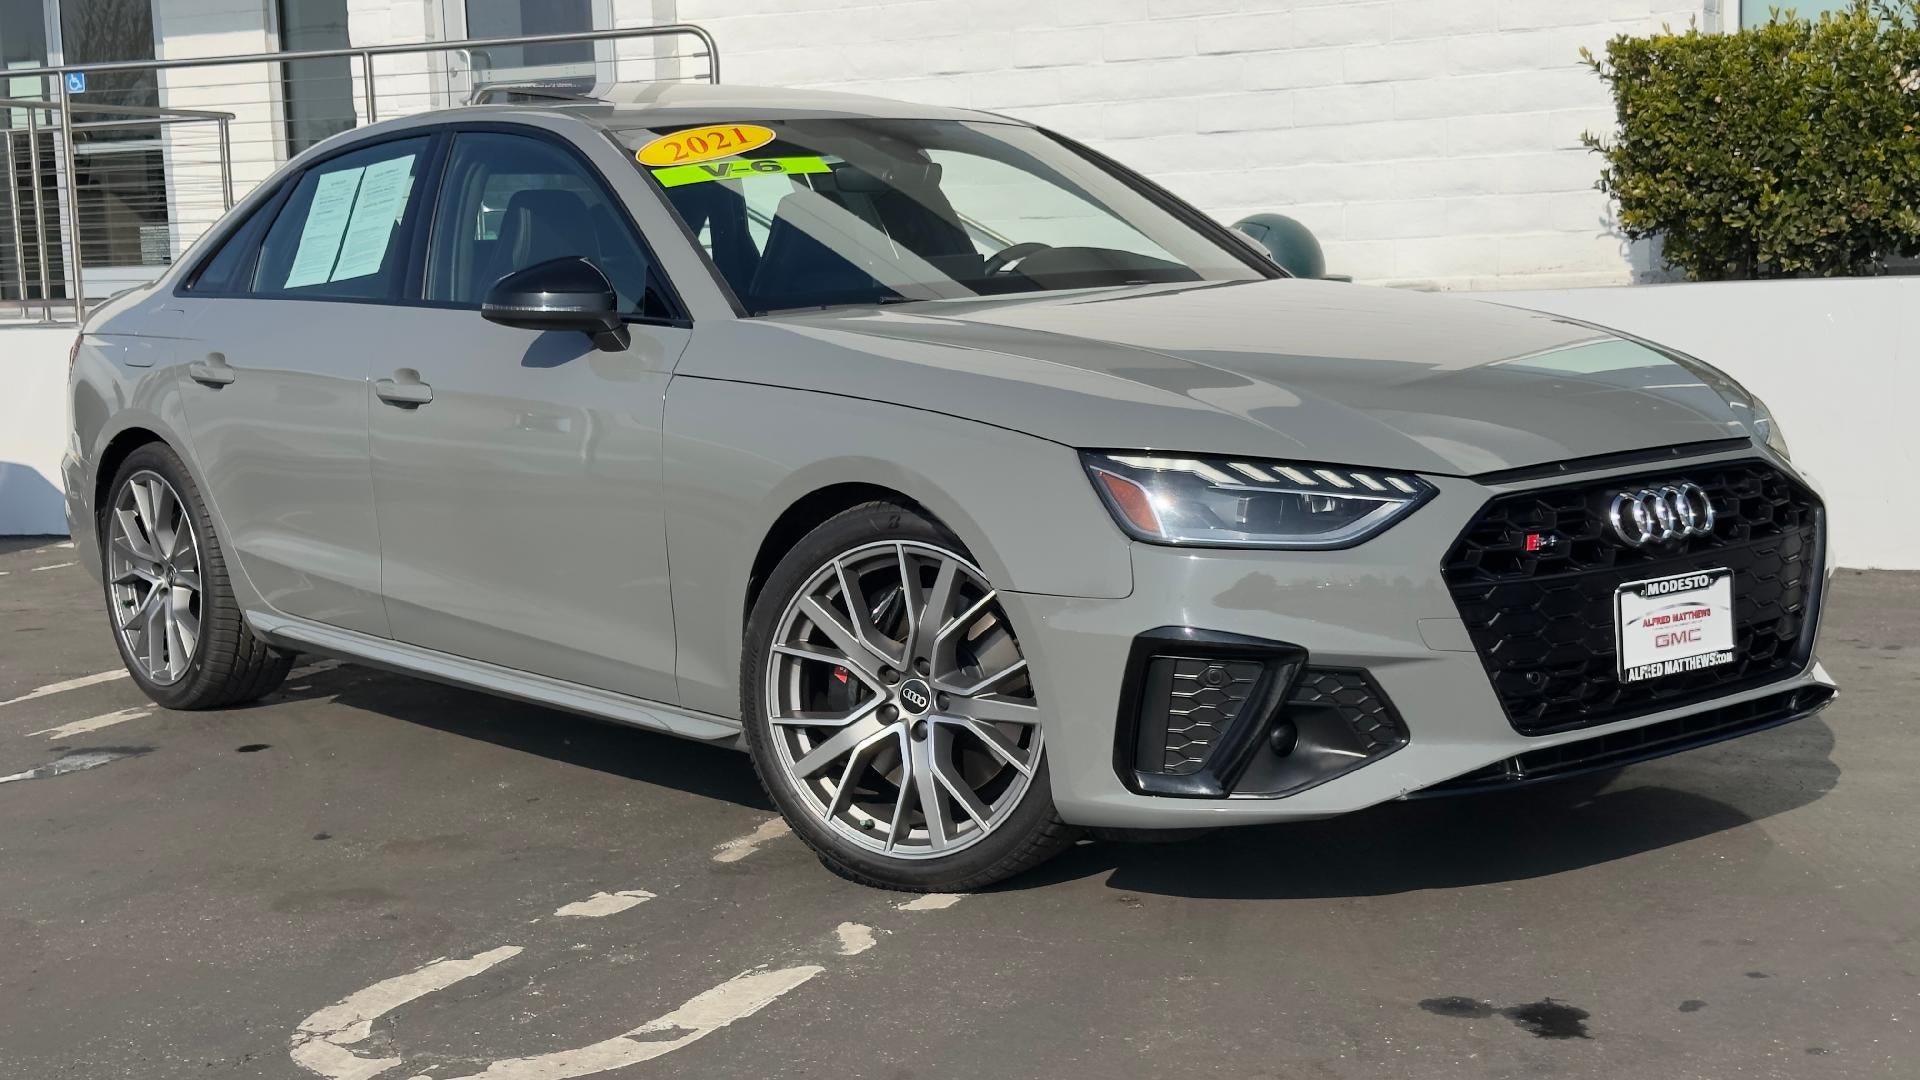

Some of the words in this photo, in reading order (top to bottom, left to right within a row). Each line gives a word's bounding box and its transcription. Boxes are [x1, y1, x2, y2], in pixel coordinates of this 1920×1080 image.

[664, 127, 751, 161] 2021
[702, 160, 785, 178] V-6
[1647, 575, 1709, 596] MODESTO
[1642, 615, 1670, 628] ALFRED
[1672, 608, 1711, 622] MATTHEWS
[1655, 628, 1702, 648] GMC
[1628, 663, 1663, 682] ALFRED
